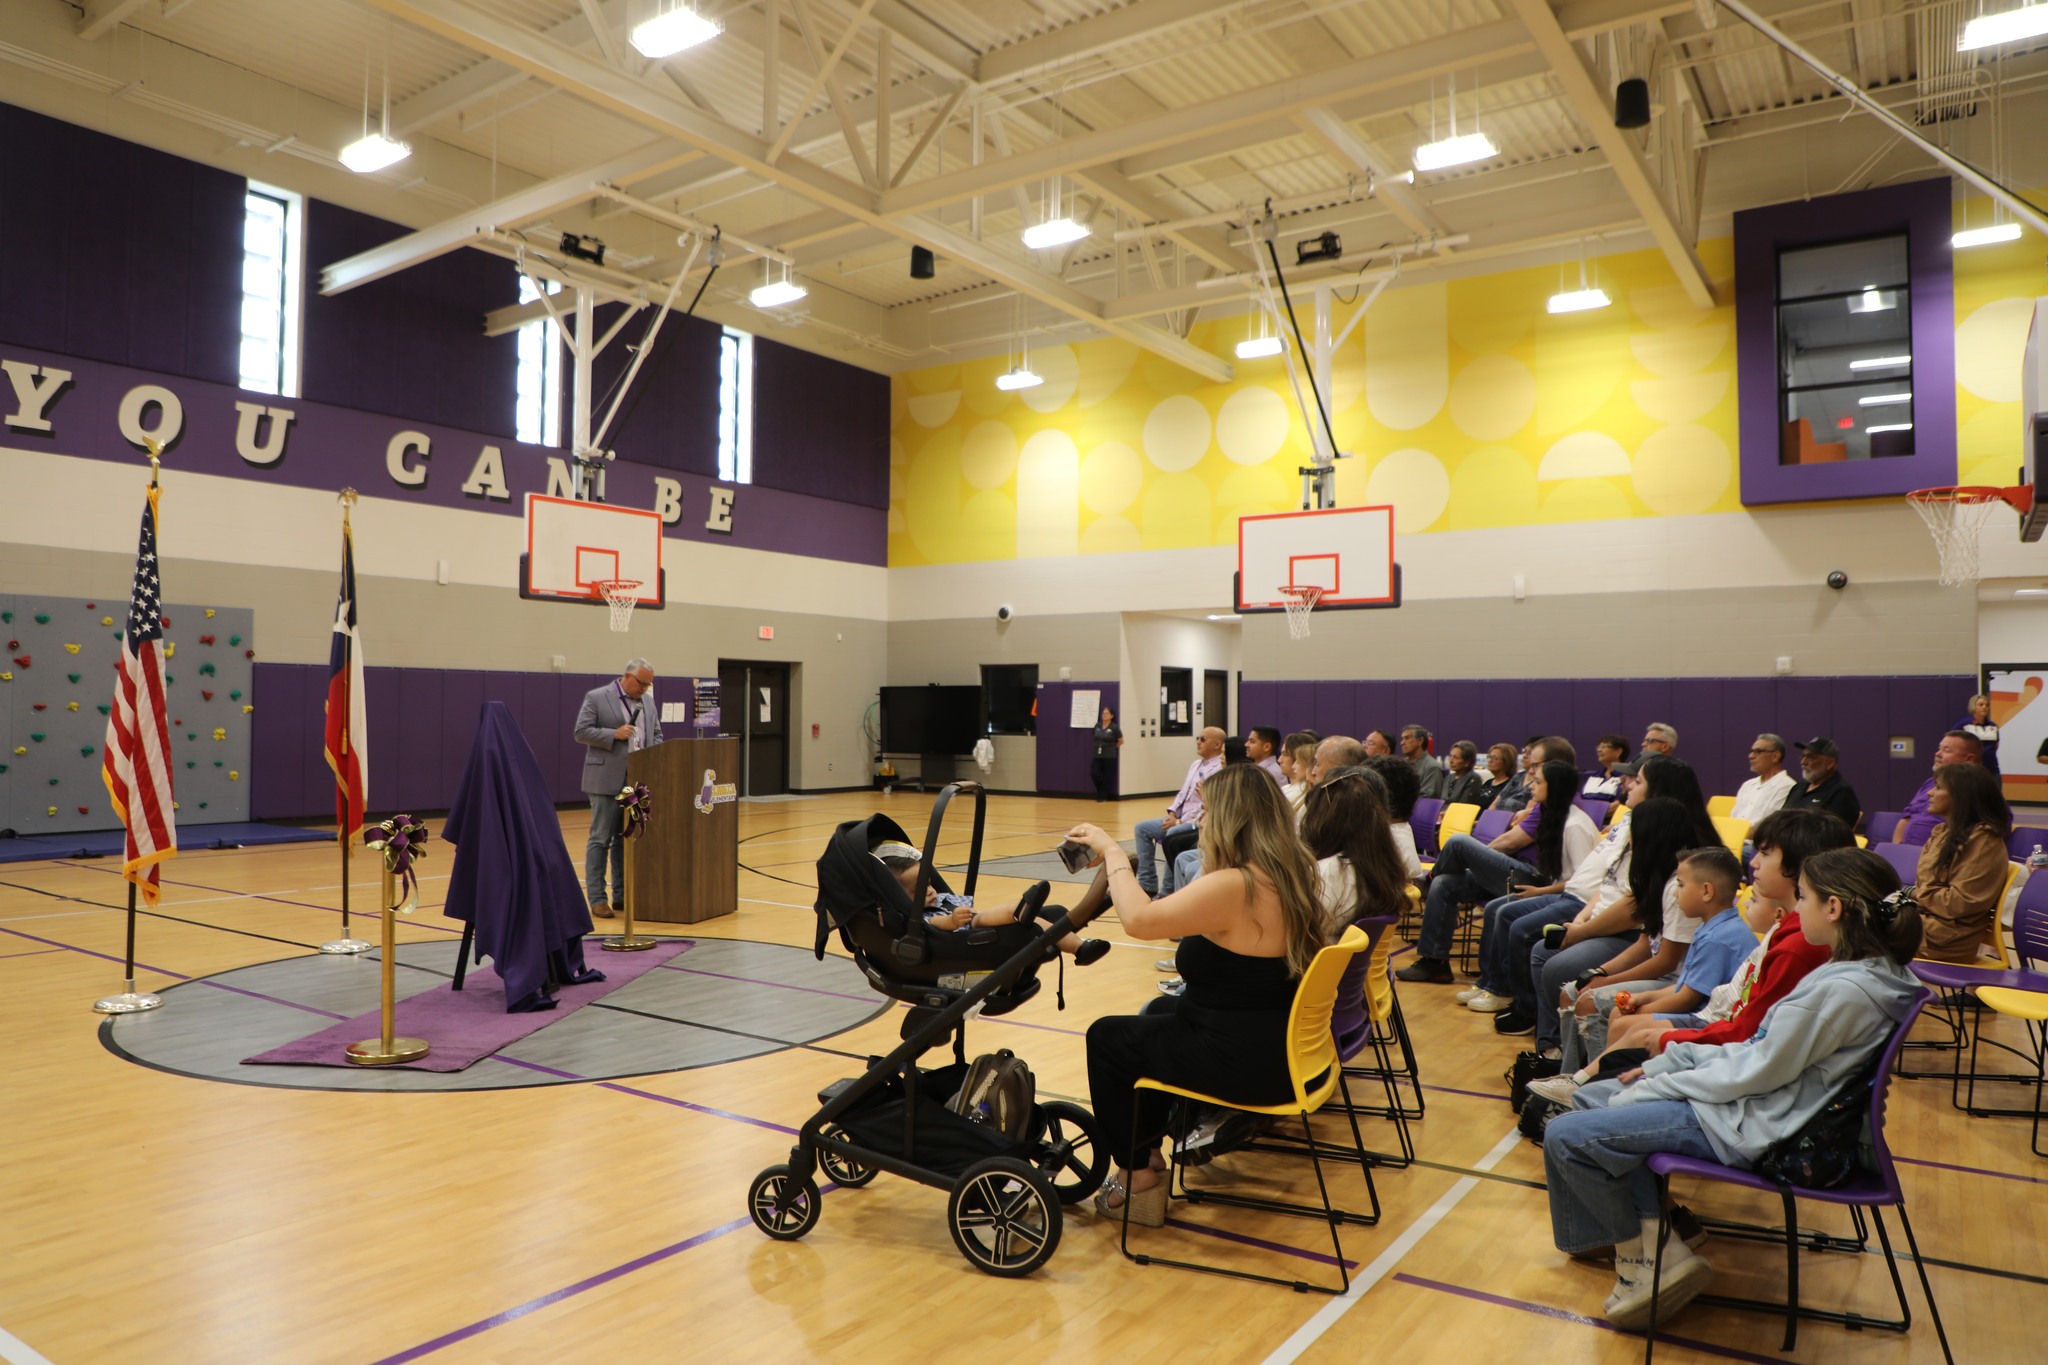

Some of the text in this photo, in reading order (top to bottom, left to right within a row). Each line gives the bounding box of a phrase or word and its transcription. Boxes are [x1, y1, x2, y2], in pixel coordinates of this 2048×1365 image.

[1, 359, 734, 532] YOU CAN BE
